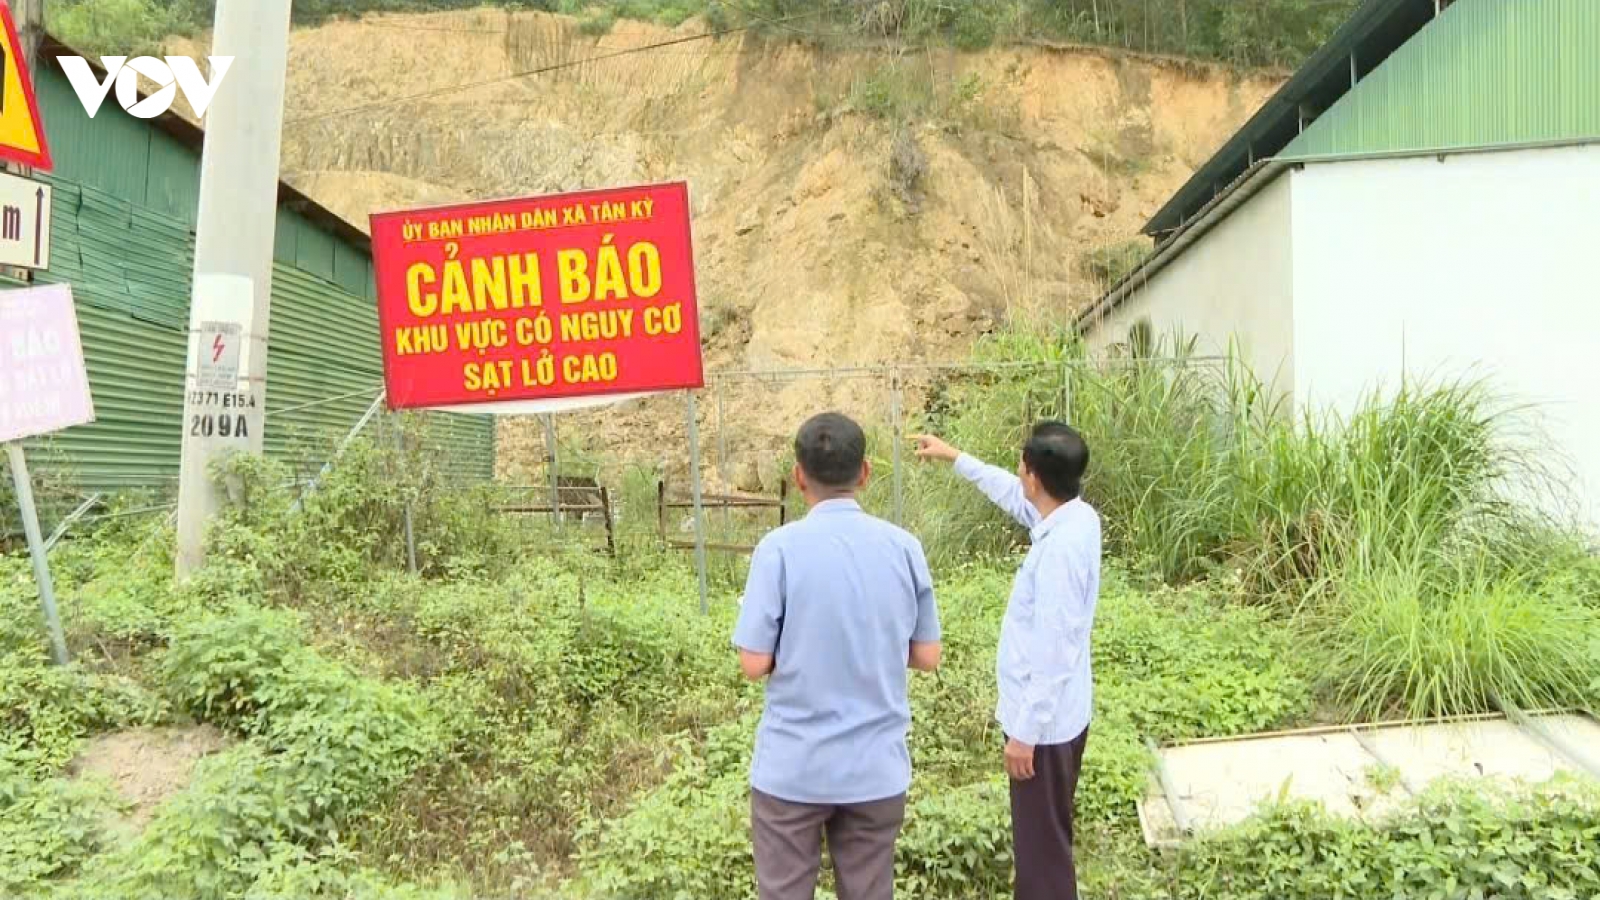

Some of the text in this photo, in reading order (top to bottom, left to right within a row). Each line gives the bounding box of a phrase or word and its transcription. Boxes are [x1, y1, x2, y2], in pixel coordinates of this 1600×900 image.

[2, 205, 20, 241] m
[402, 221, 422, 240] ỦY
[428, 219, 462, 236] BAN
[468, 212, 515, 233] NHÂN
[521, 208, 556, 228] DÂN
[562, 203, 586, 224] XÃ
[591, 201, 626, 220] TÂN
[406, 234, 662, 317] CẢNH BÁO
[396, 302, 682, 355] KHU VỰC CÓ NGUY CƠ
[463, 348, 618, 395] SẠT LỞ CAO
[223, 391, 256, 407] E15.4
[190, 413, 248, 437] 209A
